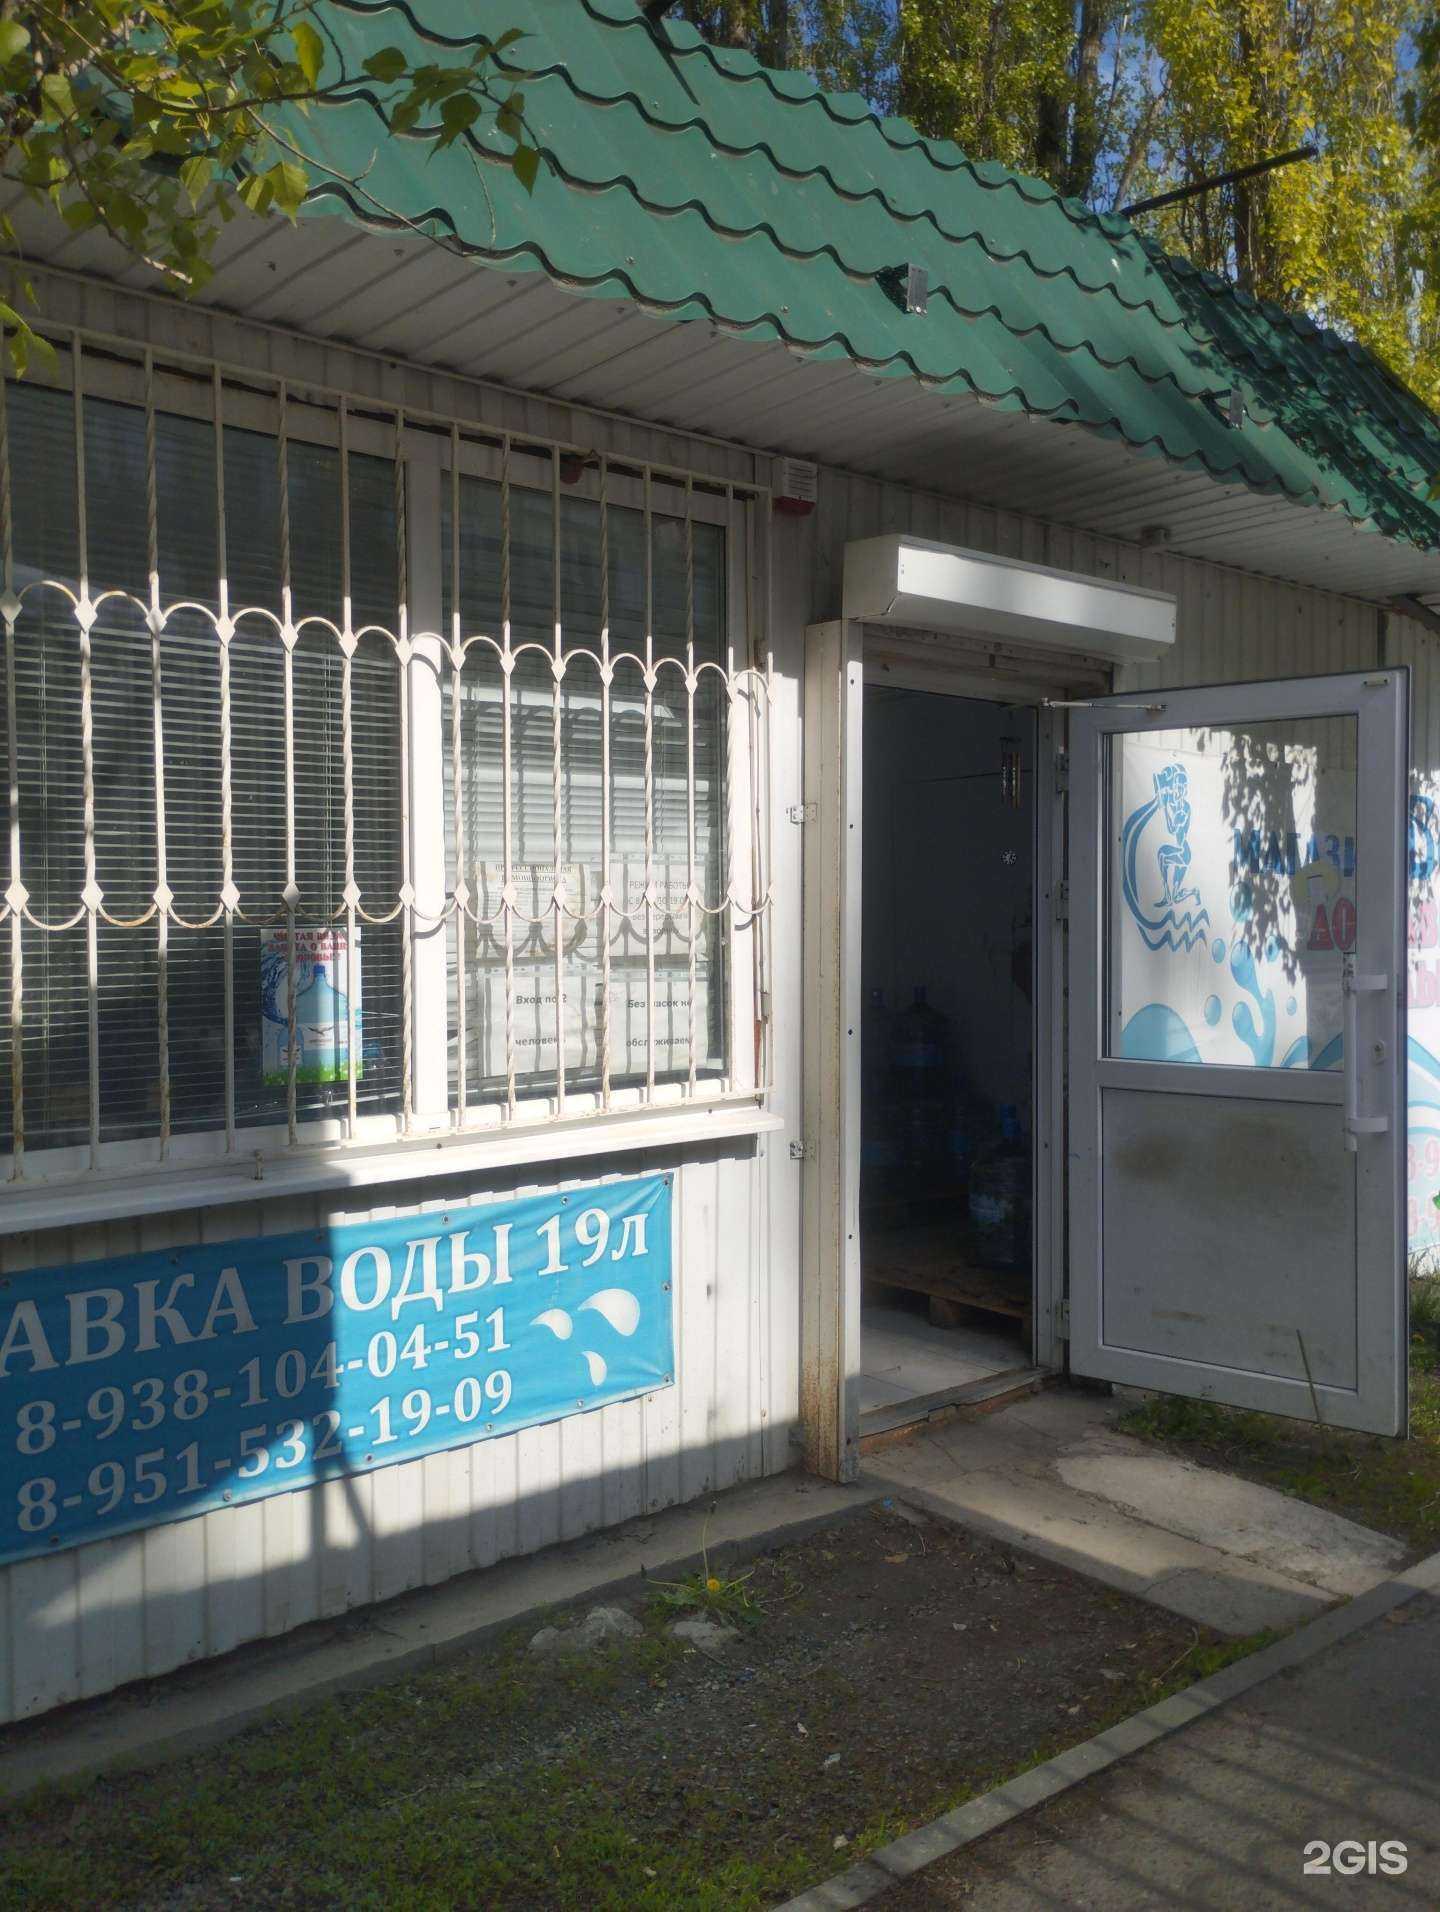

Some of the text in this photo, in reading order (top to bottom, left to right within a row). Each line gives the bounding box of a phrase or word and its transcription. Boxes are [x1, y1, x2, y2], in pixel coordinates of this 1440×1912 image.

[515, 995, 542, 1006] Вход
[627, 999, 646, 1009] Без
[648, 1000, 678, 1009] асок
[515, 1037, 568, 1046] человек
[626, 1037, 693, 1048] обслживае
[0, 1208, 649, 1379] АВКА ВОДЫ 19л
[16, 1306, 511, 1455] 8-938-104-04-51
[16, 1370, 512, 1532] 8-951-532-19-09
